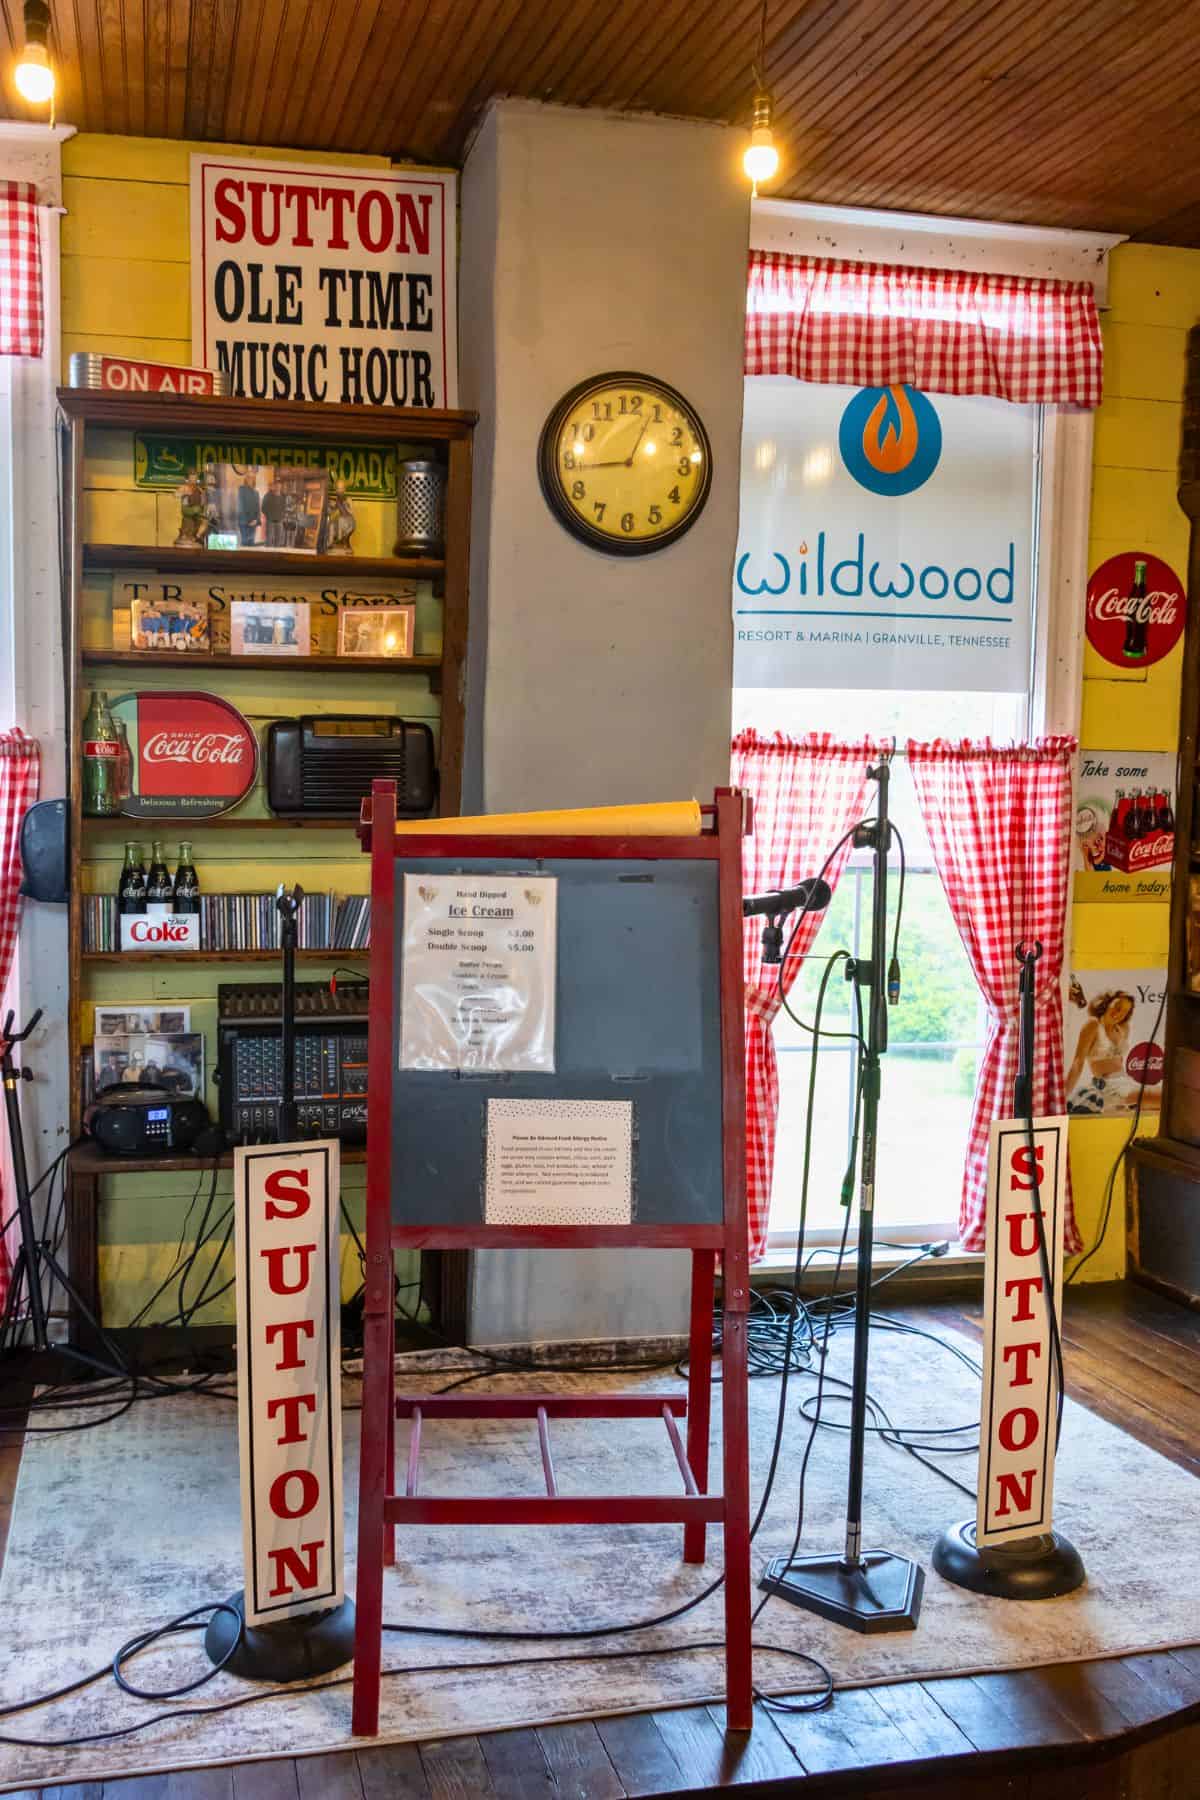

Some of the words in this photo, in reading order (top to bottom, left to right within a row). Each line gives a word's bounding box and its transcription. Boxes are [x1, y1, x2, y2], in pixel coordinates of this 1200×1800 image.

[214, 178, 433, 255] SUTTON
[214, 260, 303, 326] OLE
[320, 268, 433, 332] TIME
[106, 364, 148, 391] ON
[159, 373, 207, 395] AIR
[216, 340, 327, 402] MUSIC
[339, 347, 435, 408] HOUR
[591, 402, 614, 421] 11
[617, 395, 643, 416] 12
[652, 404, 663, 423] 1
[669, 427, 682, 447] 2
[677, 457, 692, 476] 3
[571, 480, 586, 501] 8
[667, 485, 681, 504] 4
[592, 501, 607, 522] 7
[647, 504, 662, 525] 5
[620, 512, 635, 533] 6
[736, 531, 1014, 604] wildwood
[1095, 588, 1178, 625] Coca-Cola
[737, 630, 793, 642] RESORT
[796, 631, 804, 642] &
[809, 631, 862, 643] MARINA
[872, 632, 945, 647] GRANVILLE,
[949, 635, 1011, 649] TENNESSEE
[143, 732, 246, 764] Coca-Cola
[1080, 760, 1109, 777] Take
[1115, 766, 1149, 777] some
[1102, 880, 1131, 893] home
[448, 904, 467, 916] Ice
[472, 905, 514, 916] Cream
[130, 920, 189, 942] Coke
[428, 928, 455, 938] Single
[457, 929, 484, 939] Scoop
[428, 942, 458, 951] Double
[461, 944, 488, 953] Scoop
[994, 1144, 1046, 1518] SUTTON
[261, 1169, 325, 1598] SUTTON
